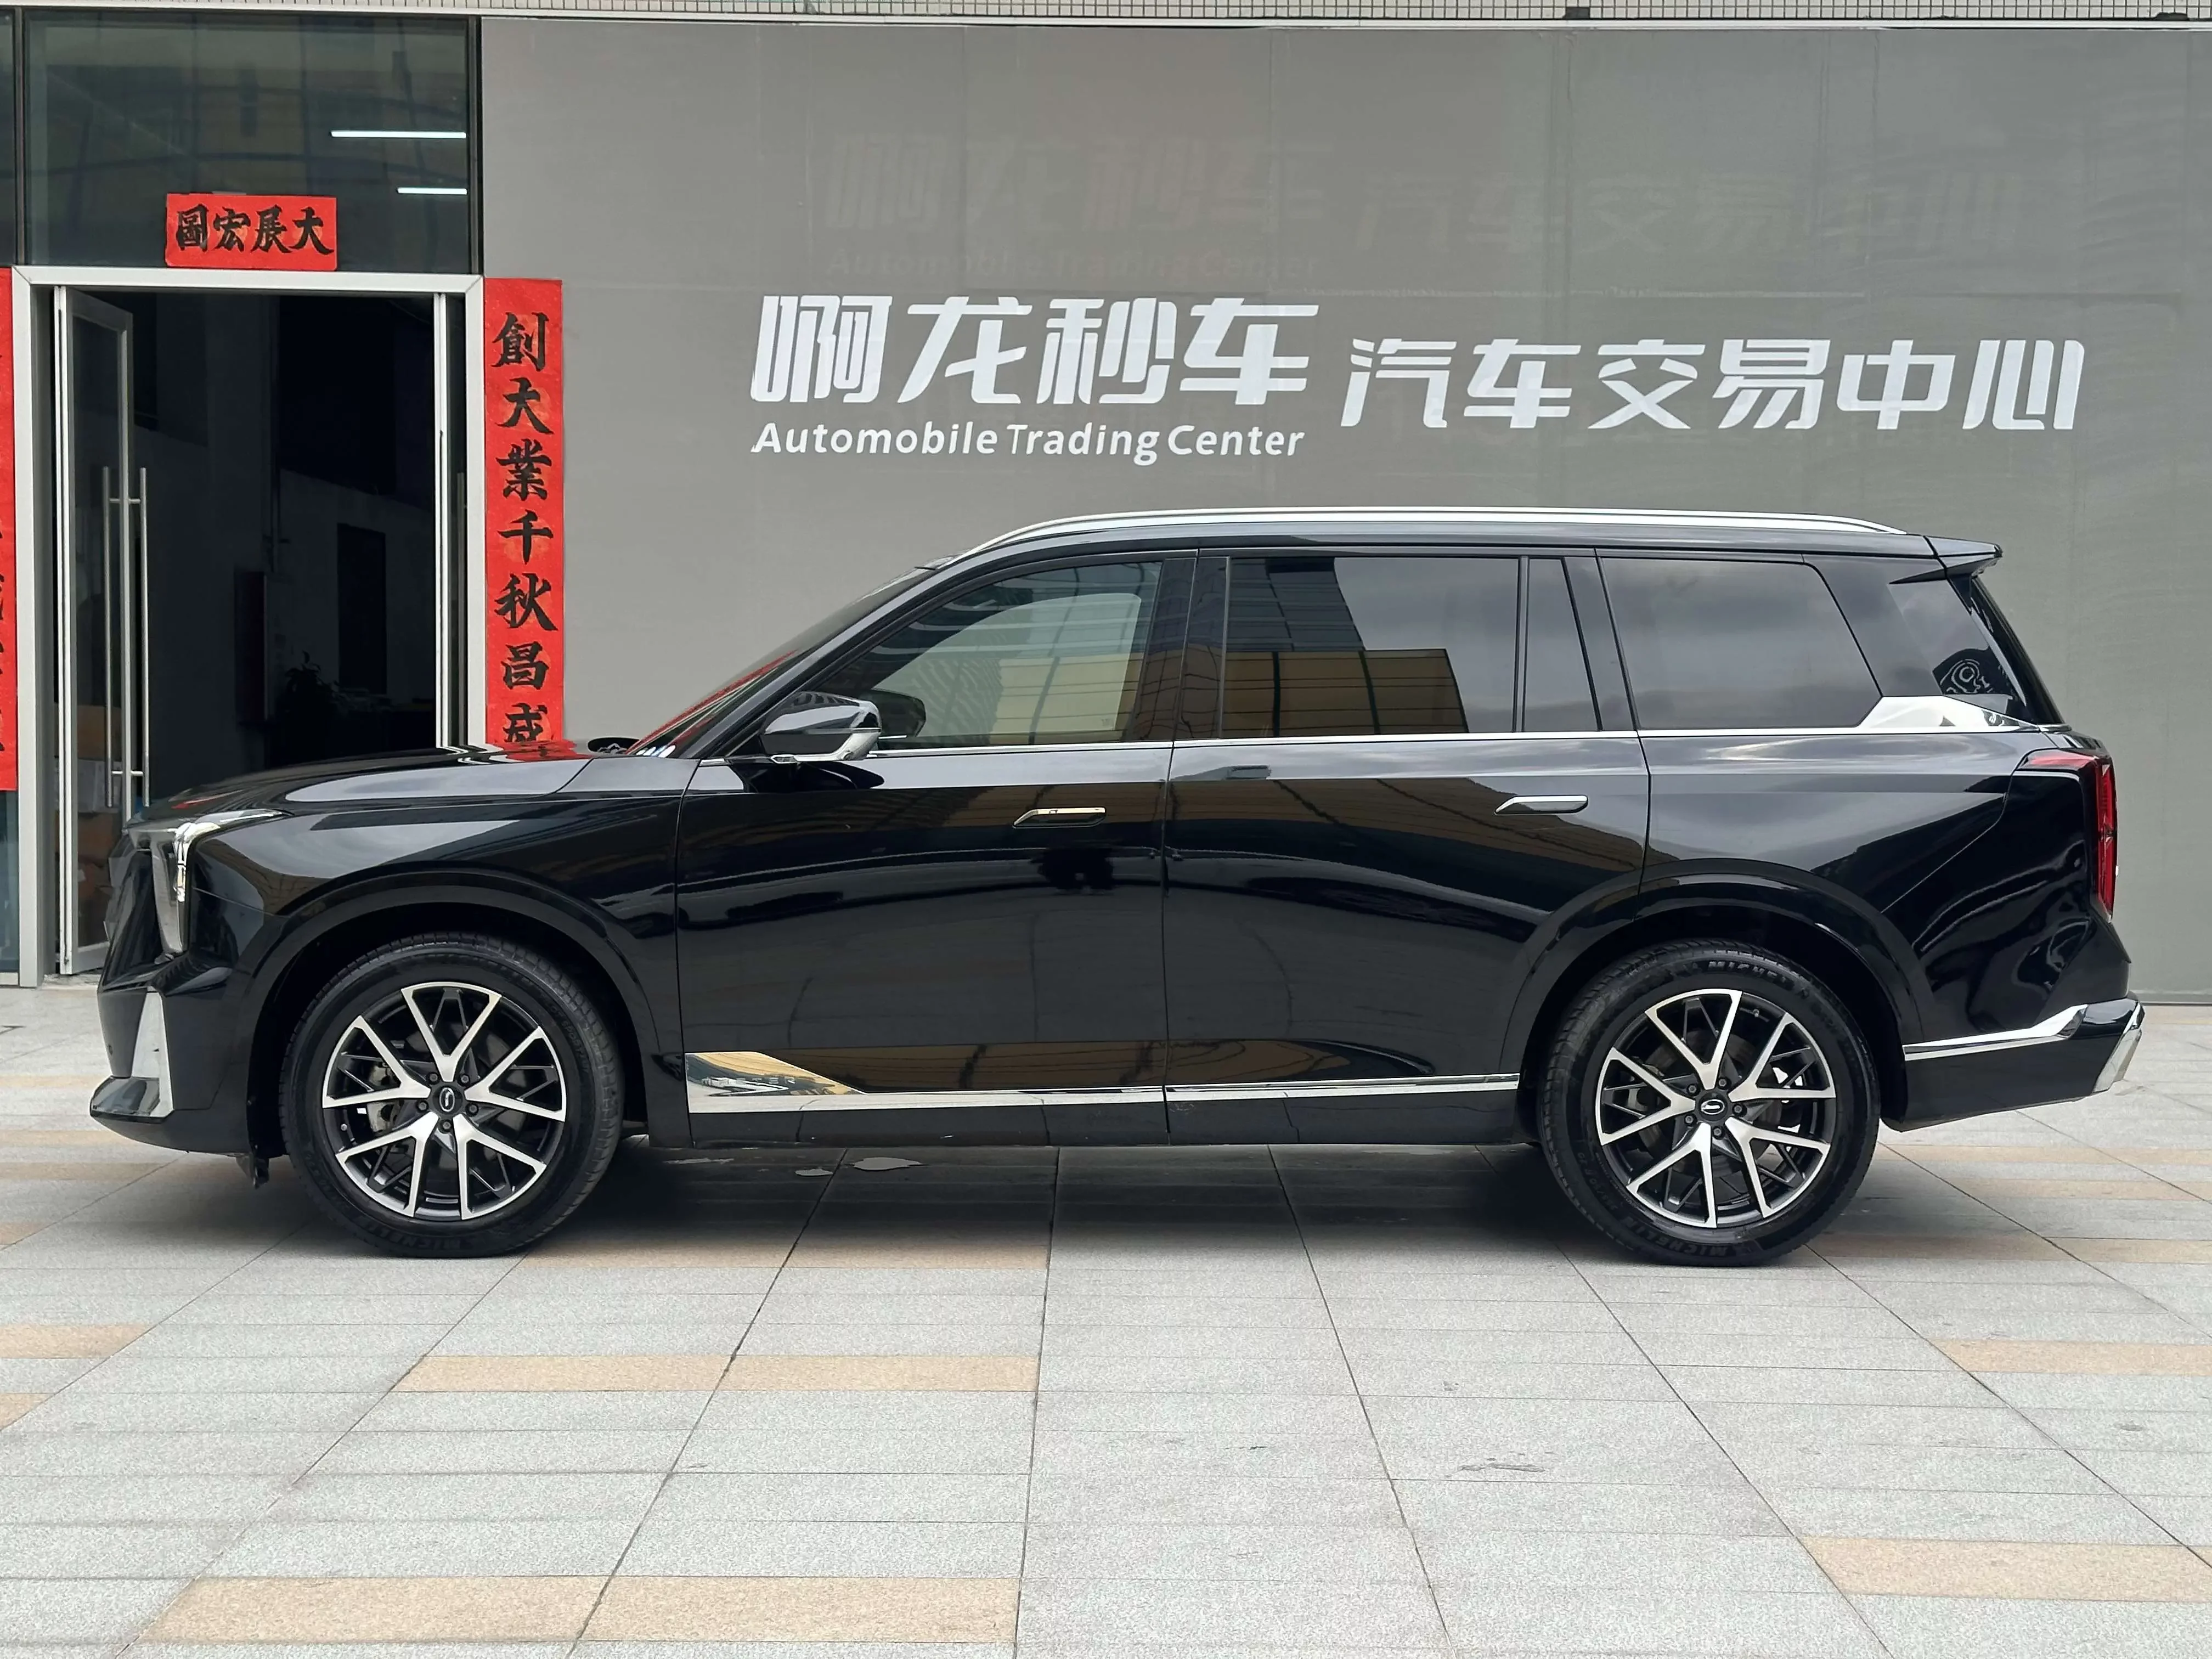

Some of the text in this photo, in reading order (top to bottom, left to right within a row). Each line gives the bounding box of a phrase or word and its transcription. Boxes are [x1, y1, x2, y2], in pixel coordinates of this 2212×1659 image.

[751, 295, 1319, 405] 啊龙秒车
[1341, 338, 2085, 431] 汽车交易中心
[751, 421, 1305, 466] Automobile Trading Center
